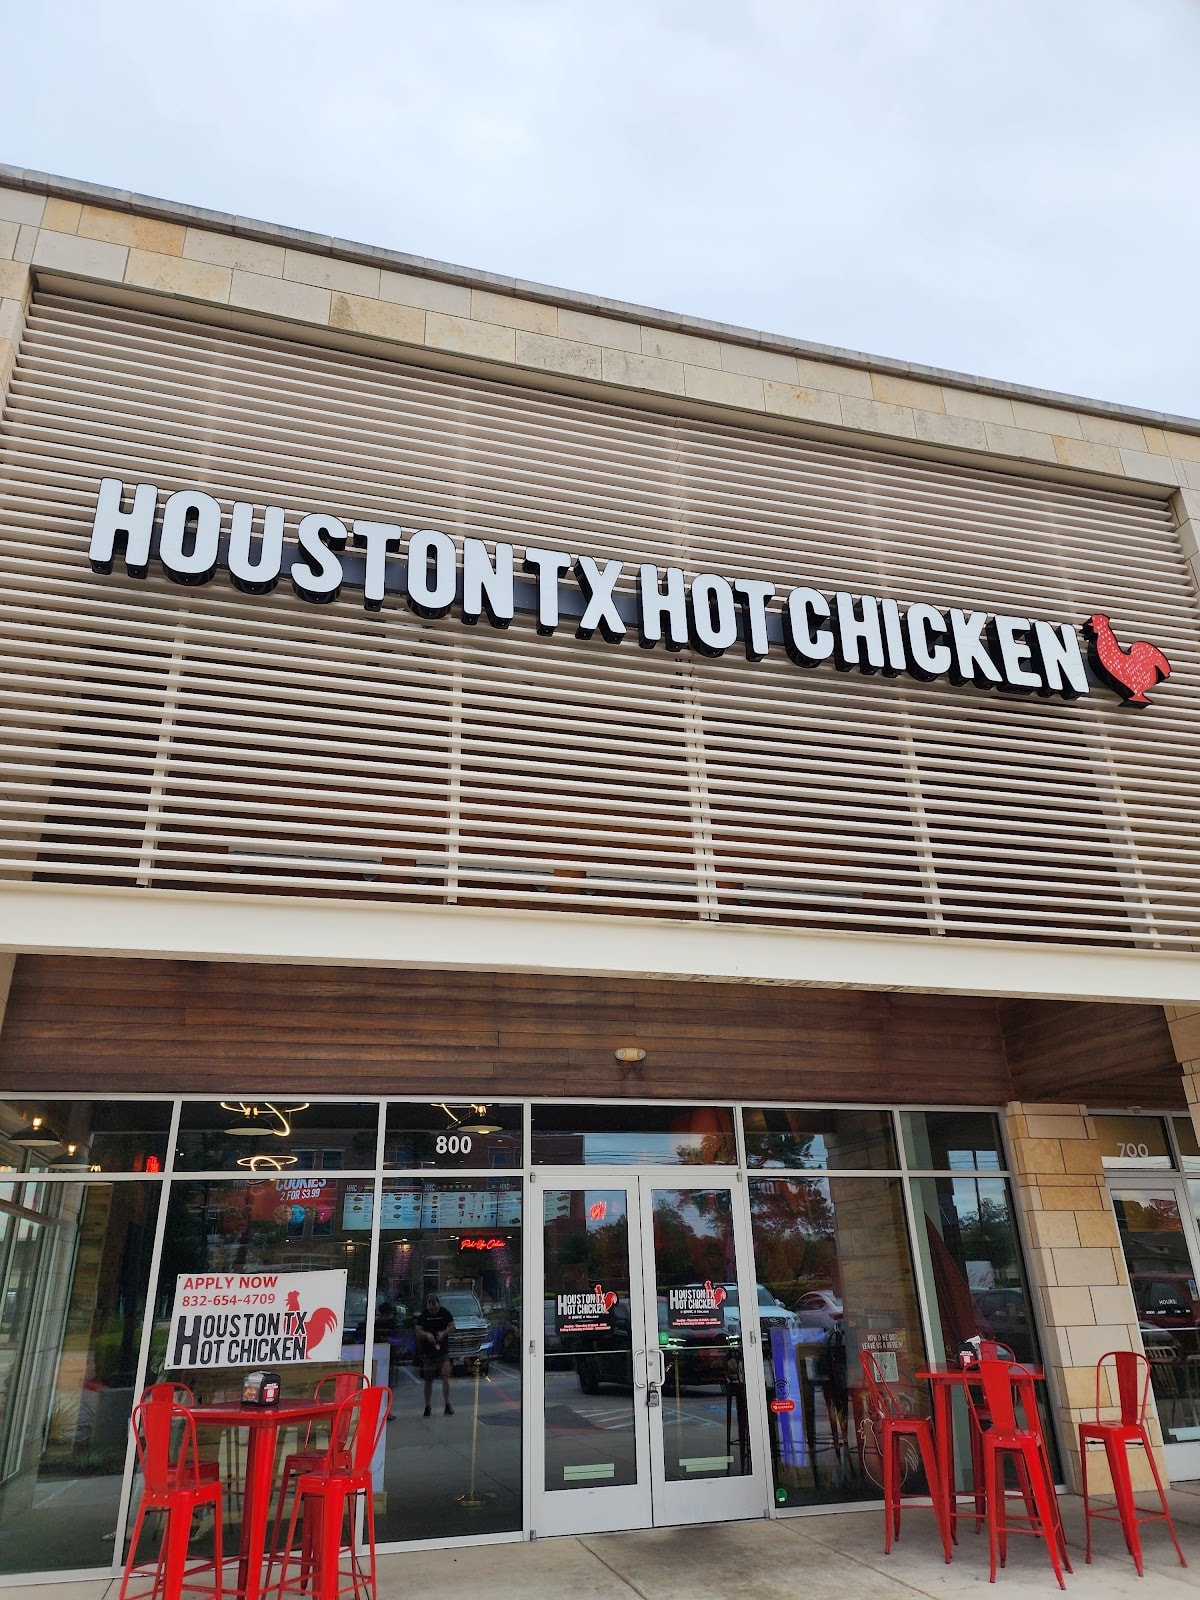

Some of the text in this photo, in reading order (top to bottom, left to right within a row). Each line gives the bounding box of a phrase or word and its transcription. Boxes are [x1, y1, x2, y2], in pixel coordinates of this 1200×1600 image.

[88, 477, 1090, 696] HOUSTON TX HOT CHICKEN
[436, 1136, 472, 1154] 800
[1117, 1143, 1149, 1157] 700
[280, 1188, 320, 1200] 2 FOR $3.99
[183, 1276, 278, 1290] APPLY NOW
[182, 1293, 276, 1307] 832-654-4709
[596, 1293, 605, 1304] TX
[705, 1289, 715, 1299] TX
[577, 1303, 606, 1314] CHICKEN
[688, 1299, 716, 1309] CHICKEN
[284, 1312, 307, 1335] TX
[227, 1336, 307, 1363] CHICKEN
